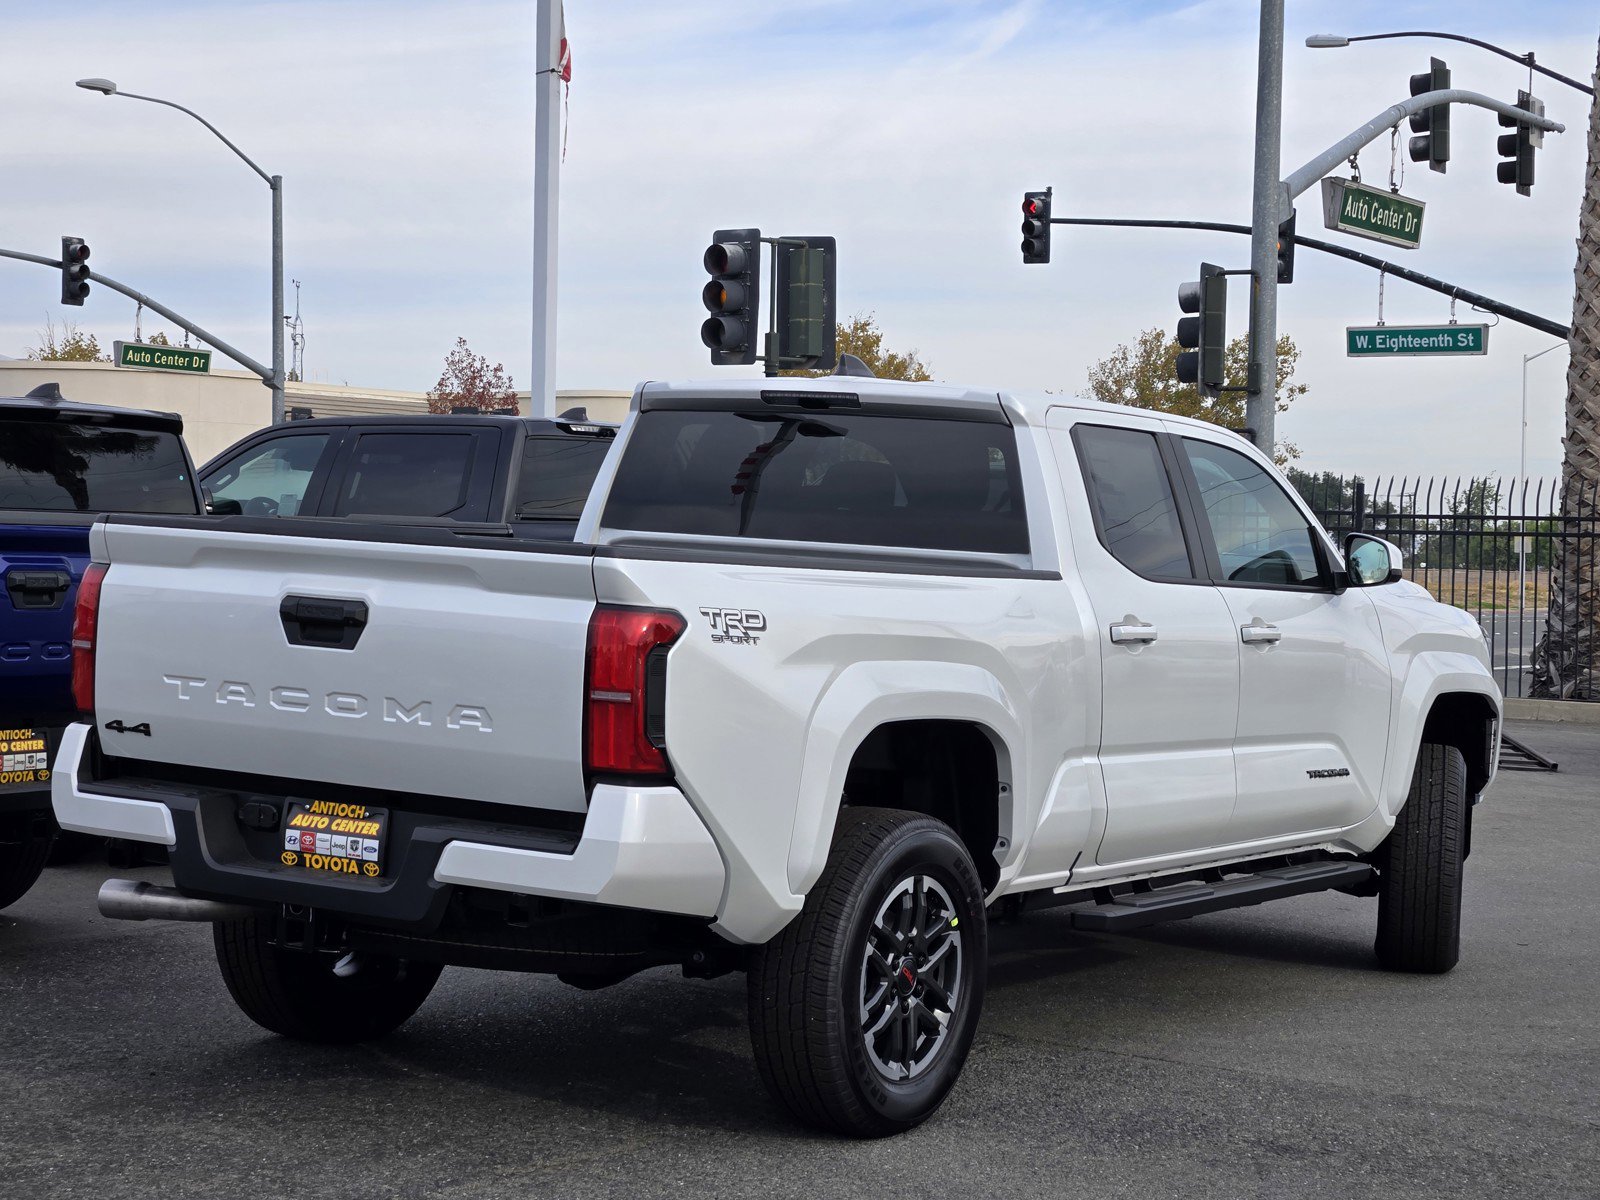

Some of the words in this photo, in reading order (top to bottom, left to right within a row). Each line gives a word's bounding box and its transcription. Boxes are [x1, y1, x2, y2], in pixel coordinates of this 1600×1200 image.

[1344, 196, 1368, 221] Auto
[1370, 202, 1403, 229] Center
[1405, 211, 1418, 234] Dr
[1356, 335, 1372, 349] W.
[1376, 333, 1453, 352] Eighteenth
[1457, 333, 1474, 347] St
[127, 350, 151, 363] Auto
[154, 352, 190, 367] Center
[192, 356, 206, 368] Dr
[699, 606, 767, 638] TRD
[711, 634, 761, 646] SPORT
[163, 674, 493, 732] TACOMA
[11, 740, 44, 751] CENTER
[0, 771, 34, 783] OYOTA
[310, 800, 365, 818] ANTIOCH
[289, 814, 330, 829] AUTO
[331, 818, 380, 836] CENTER
[331, 842, 346, 851] Jeep
[303, 853, 359, 874] TOYOTA
